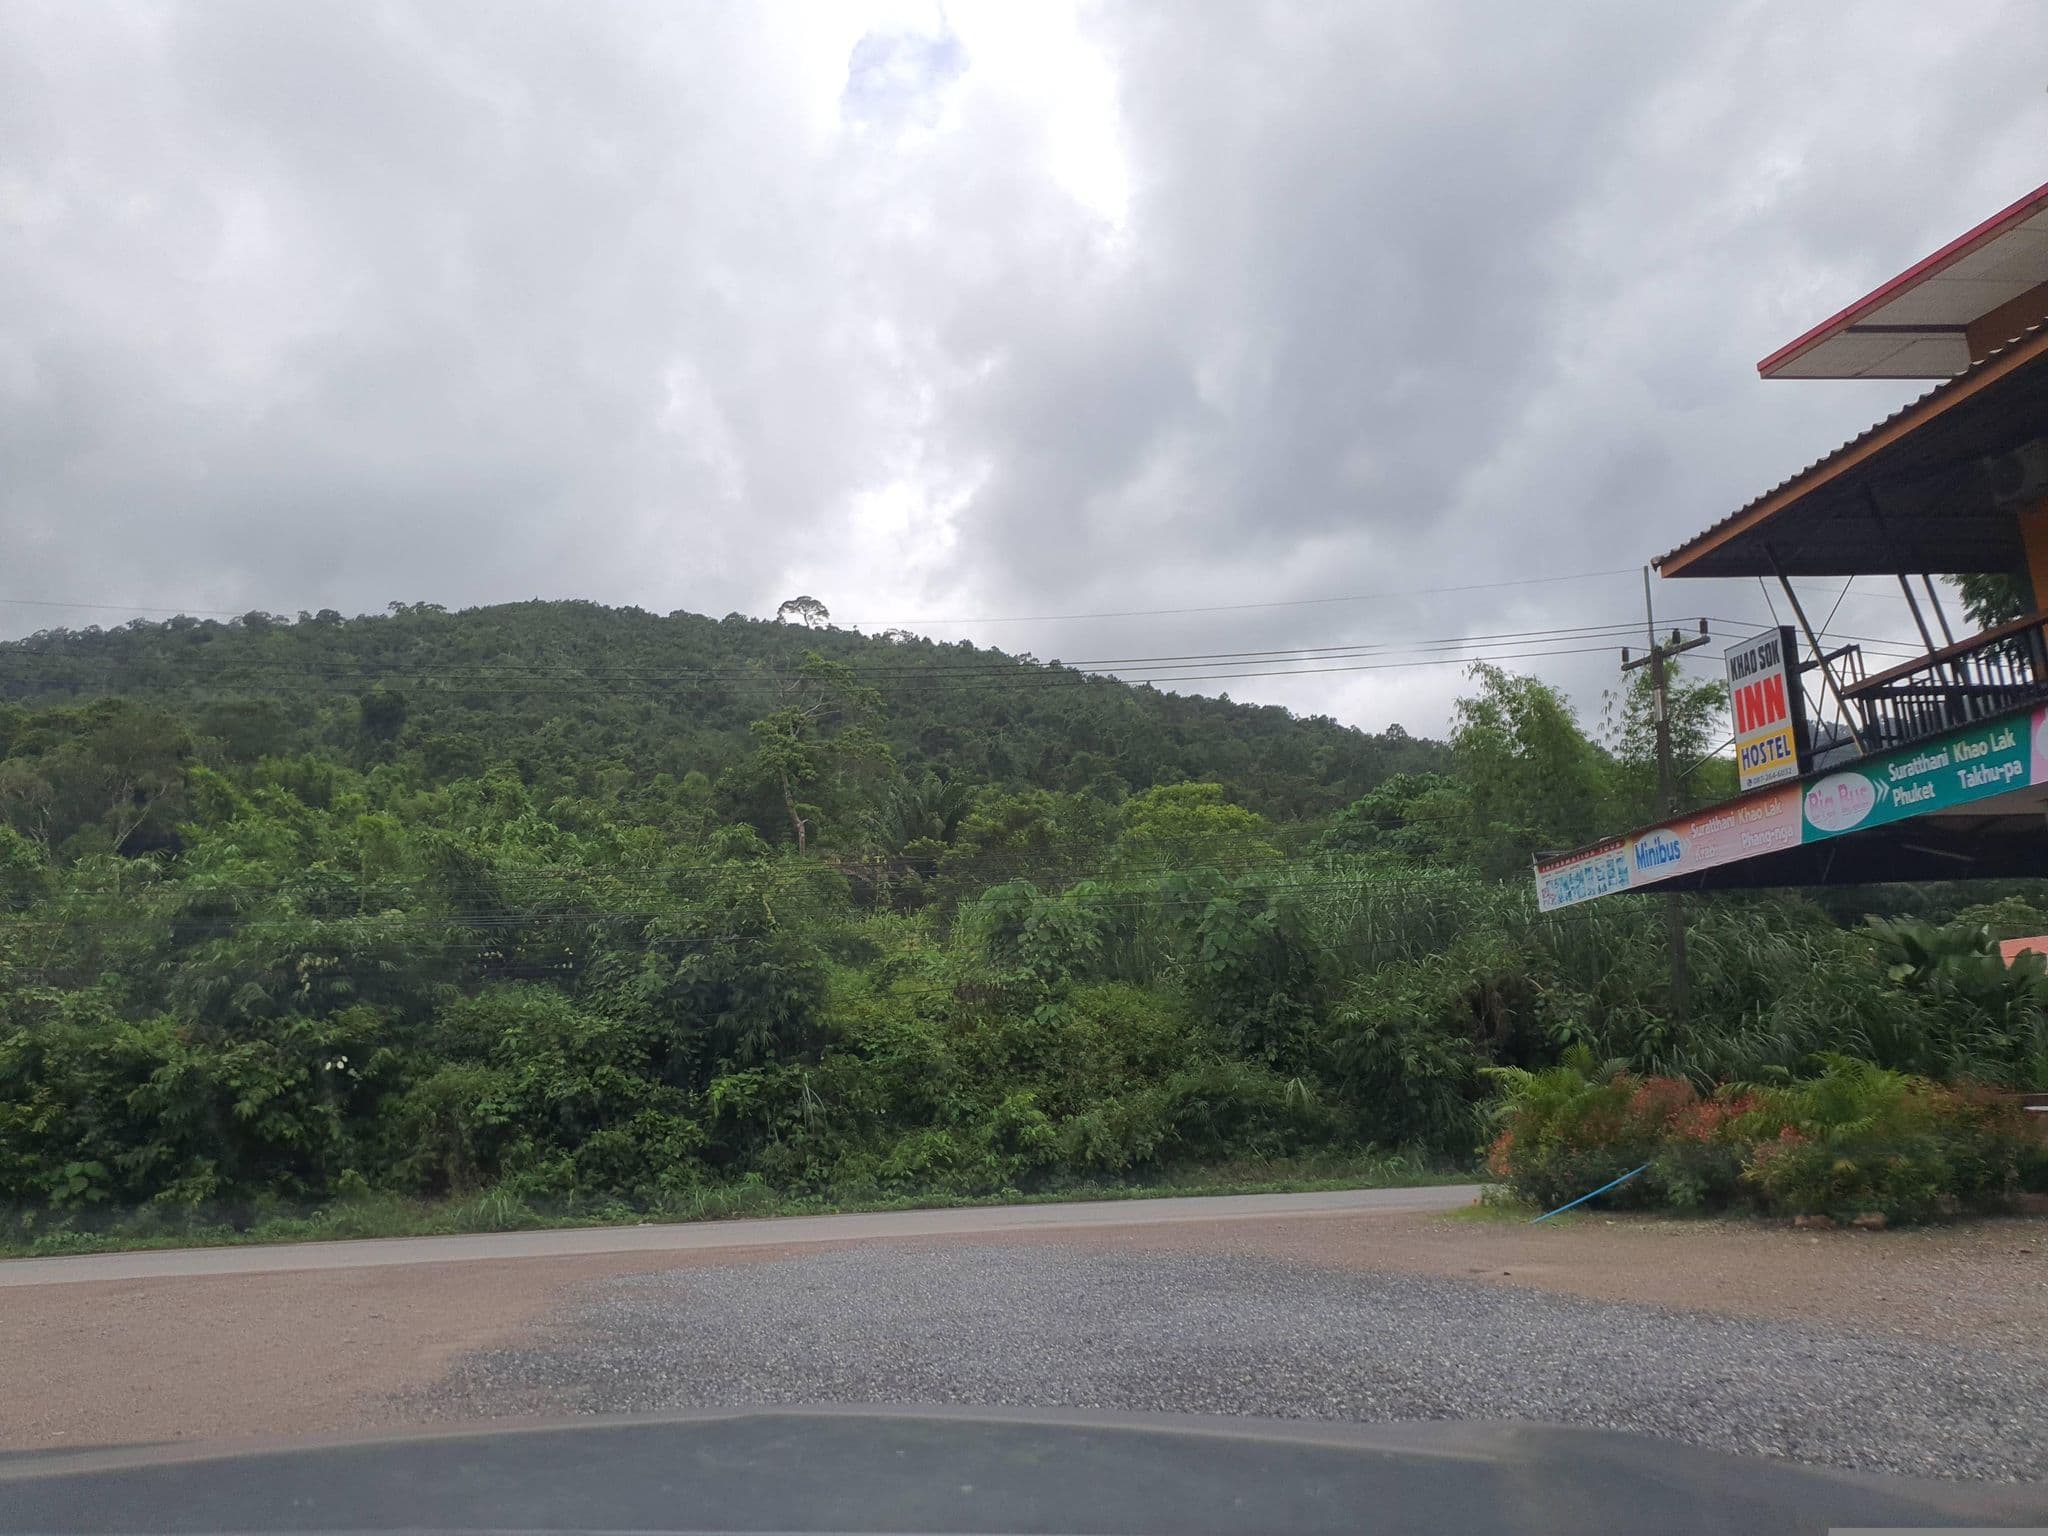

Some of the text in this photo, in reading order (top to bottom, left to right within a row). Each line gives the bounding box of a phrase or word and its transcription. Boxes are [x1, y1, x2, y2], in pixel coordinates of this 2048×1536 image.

[1730, 639, 1780, 681] KHAO SOK
[1734, 673, 1786, 734] INN
[1741, 734, 1791, 771] HOSTEL
[1888, 728, 2016, 782] Suratthani Khao Lak
[1893, 759, 2023, 807] Phuket Takhu-pa
[1691, 798, 1783, 839] Suratthani Khao Lak
[1741, 825, 1794, 849] Phang-nga
[1635, 836, 1681, 871] Minibus
